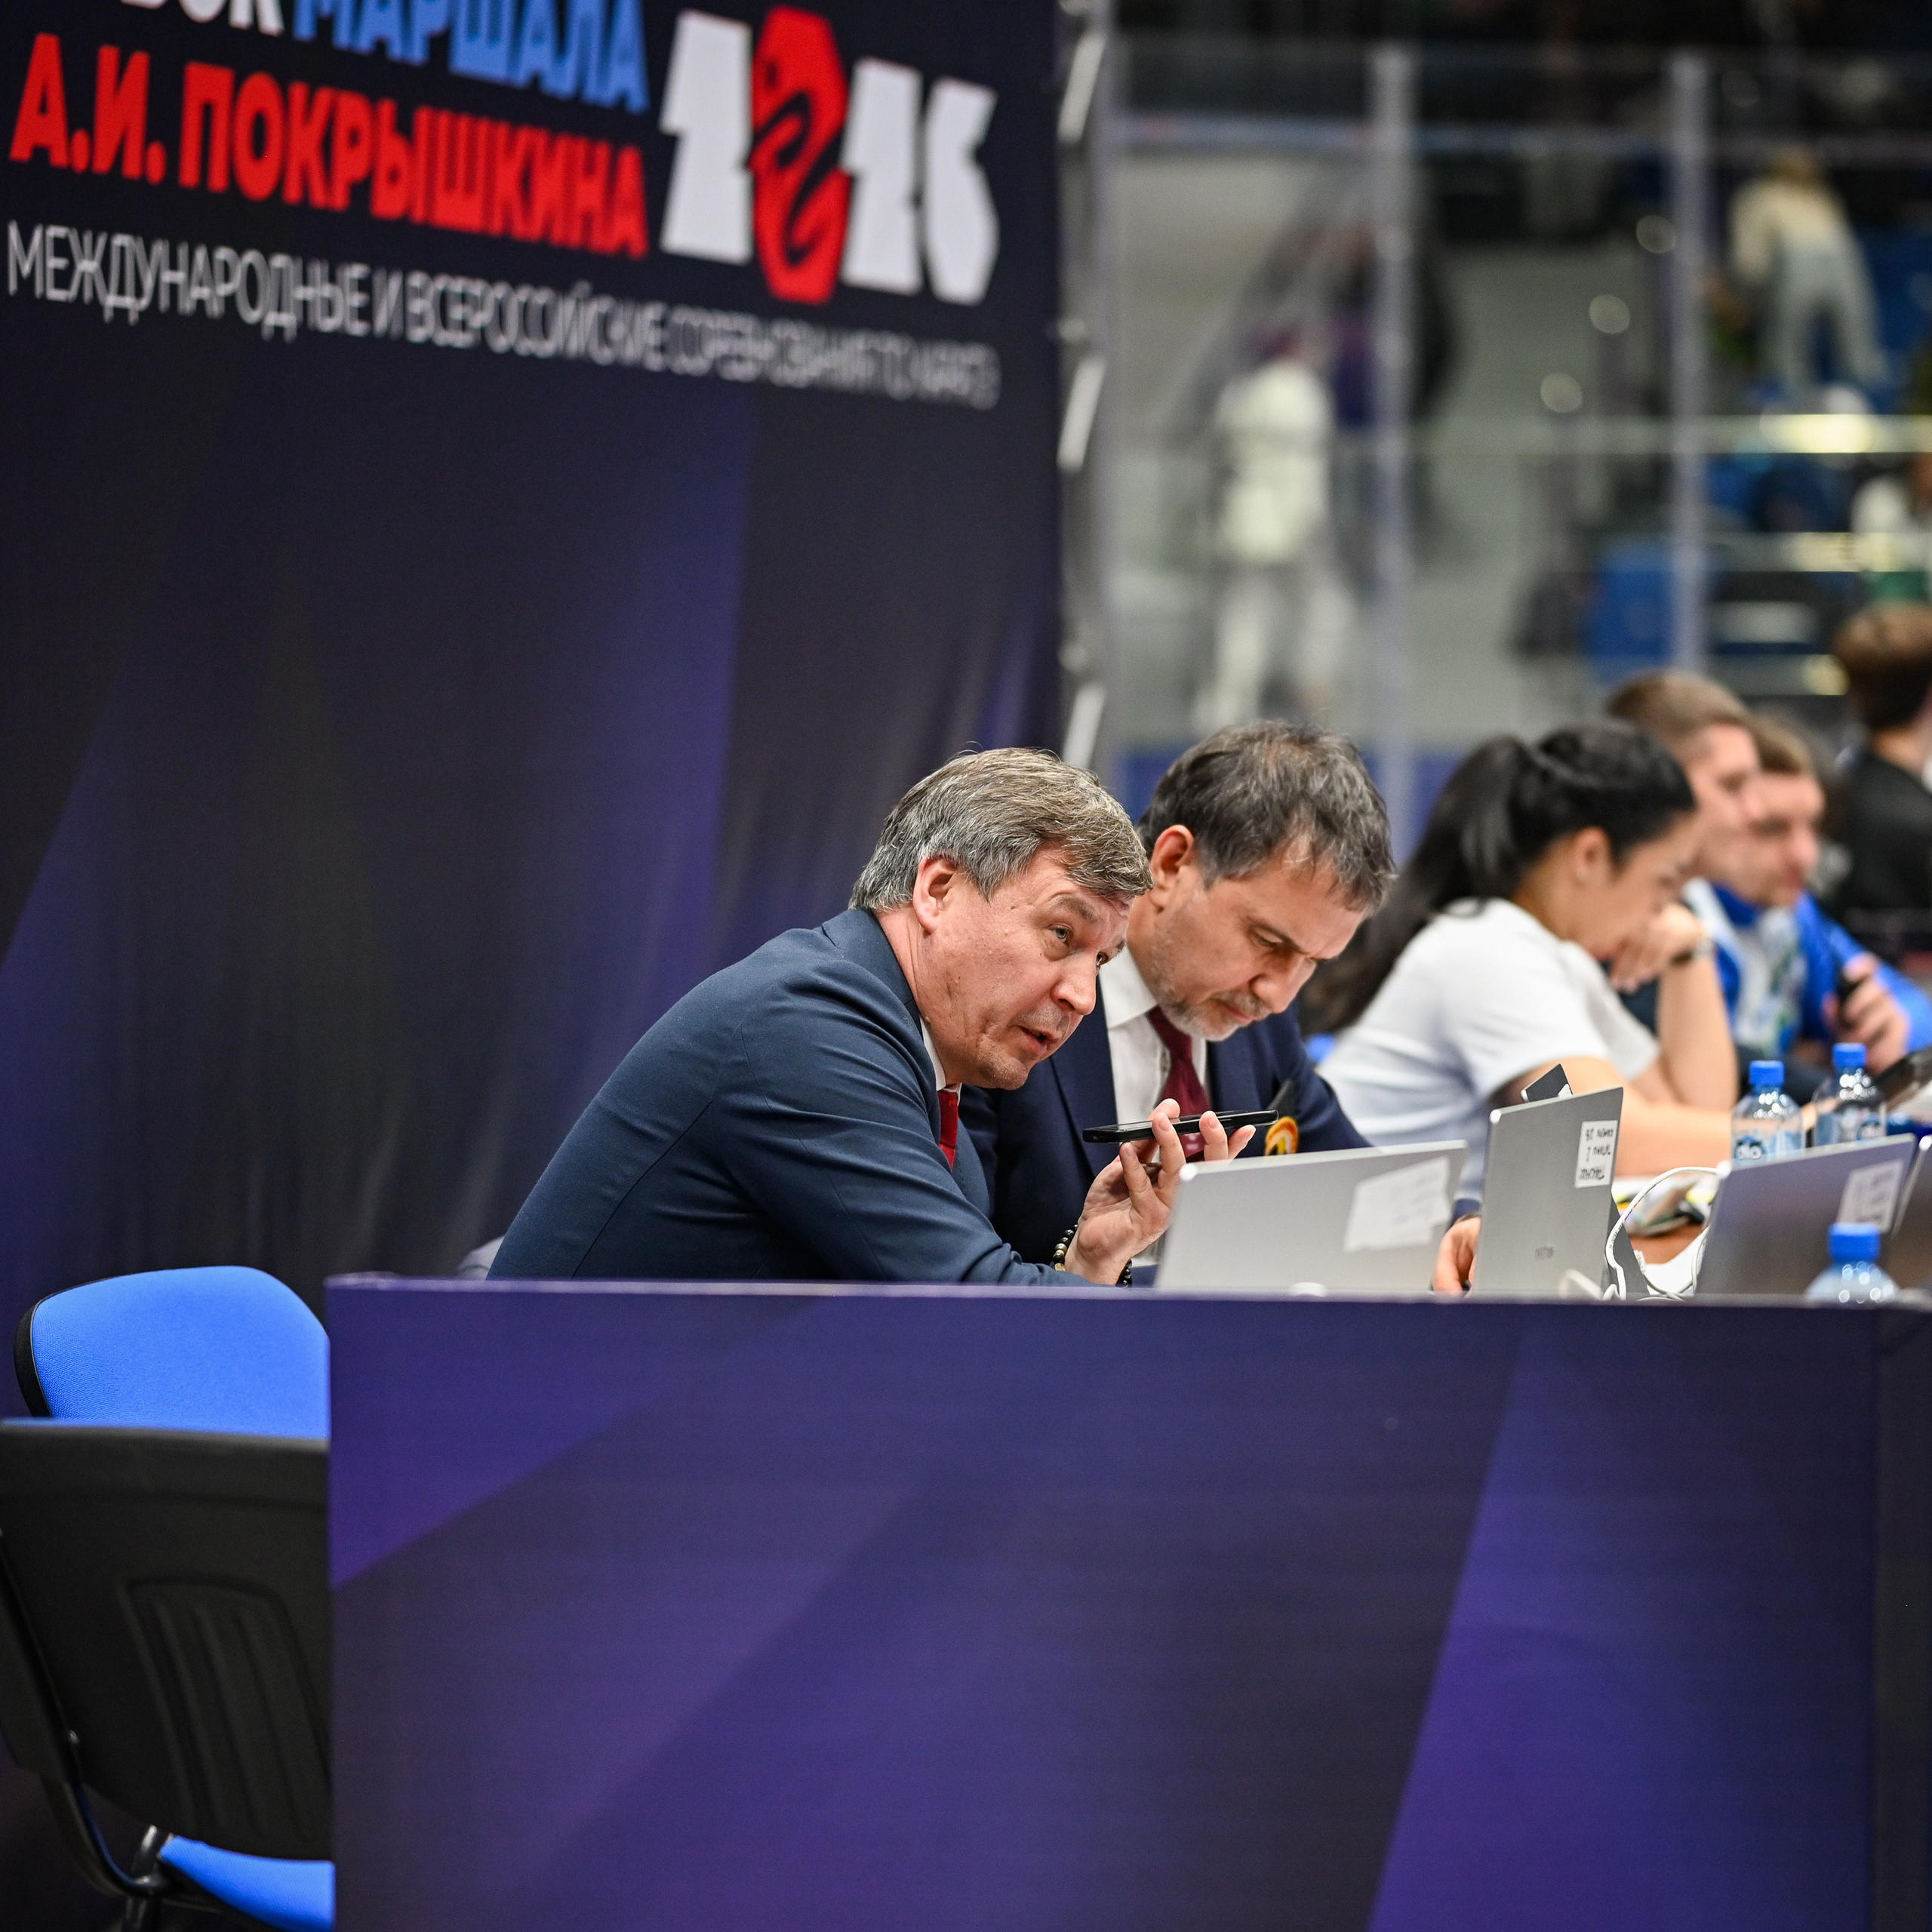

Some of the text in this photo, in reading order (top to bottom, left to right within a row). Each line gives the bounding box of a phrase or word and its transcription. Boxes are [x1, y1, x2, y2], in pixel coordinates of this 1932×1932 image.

[11, 32, 649, 259] А.И. ПОКРЫШКИНА
[8, 220, 371, 342] МЕЖДУНАРОДНЫЕ
[372, 266, 404, 341] И
[405, 269, 666, 373] ВСЕРОССИЙСКИЕ
